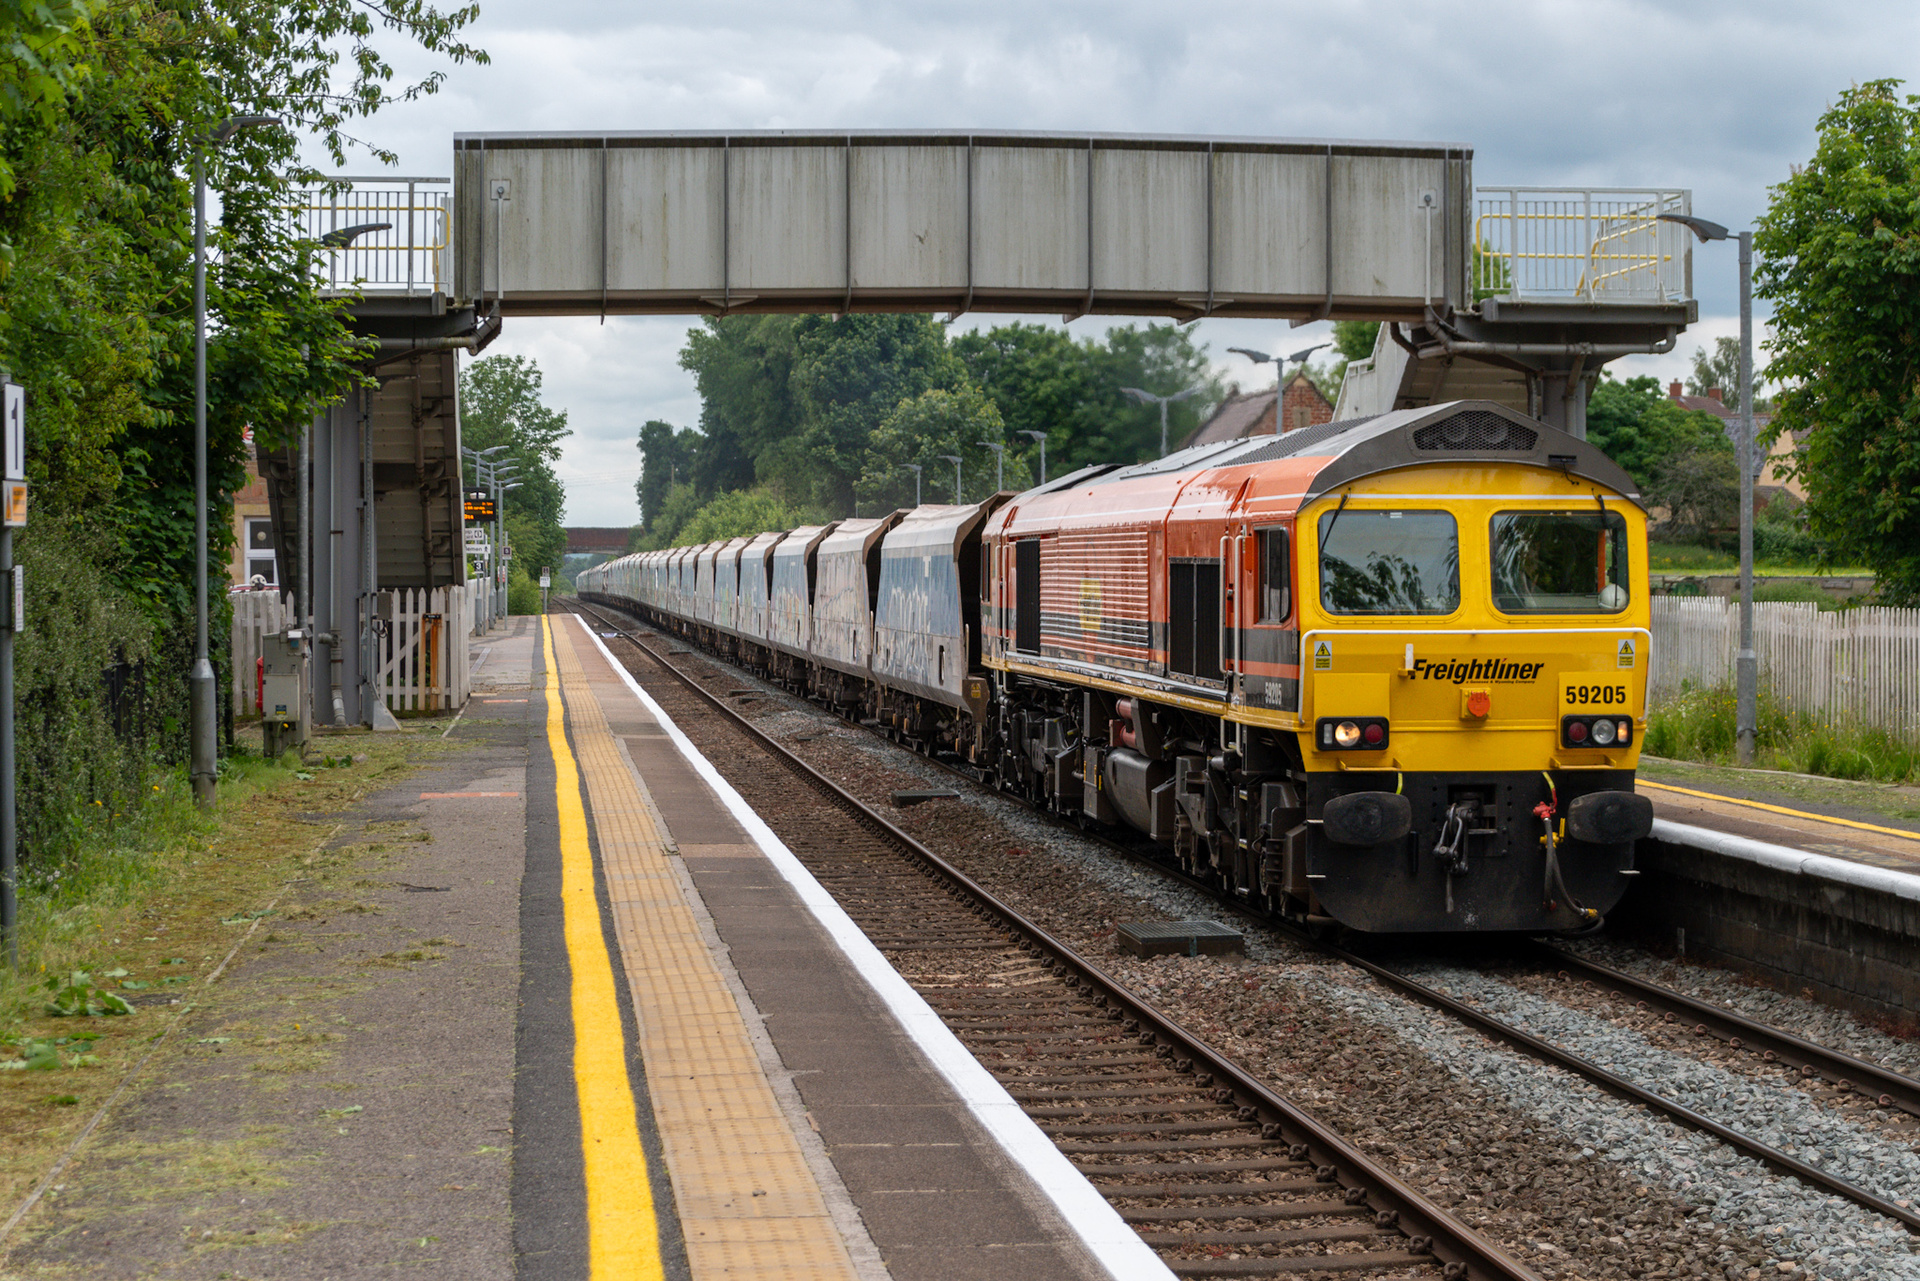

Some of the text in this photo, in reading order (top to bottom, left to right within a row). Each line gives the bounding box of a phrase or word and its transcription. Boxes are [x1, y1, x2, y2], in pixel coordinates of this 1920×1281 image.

[11, 397, 18, 470] 1
[1410, 658, 1544, 684] Freightliner
[1265, 682, 1281, 705] 59205
[1566, 686, 1626, 704] 59205
